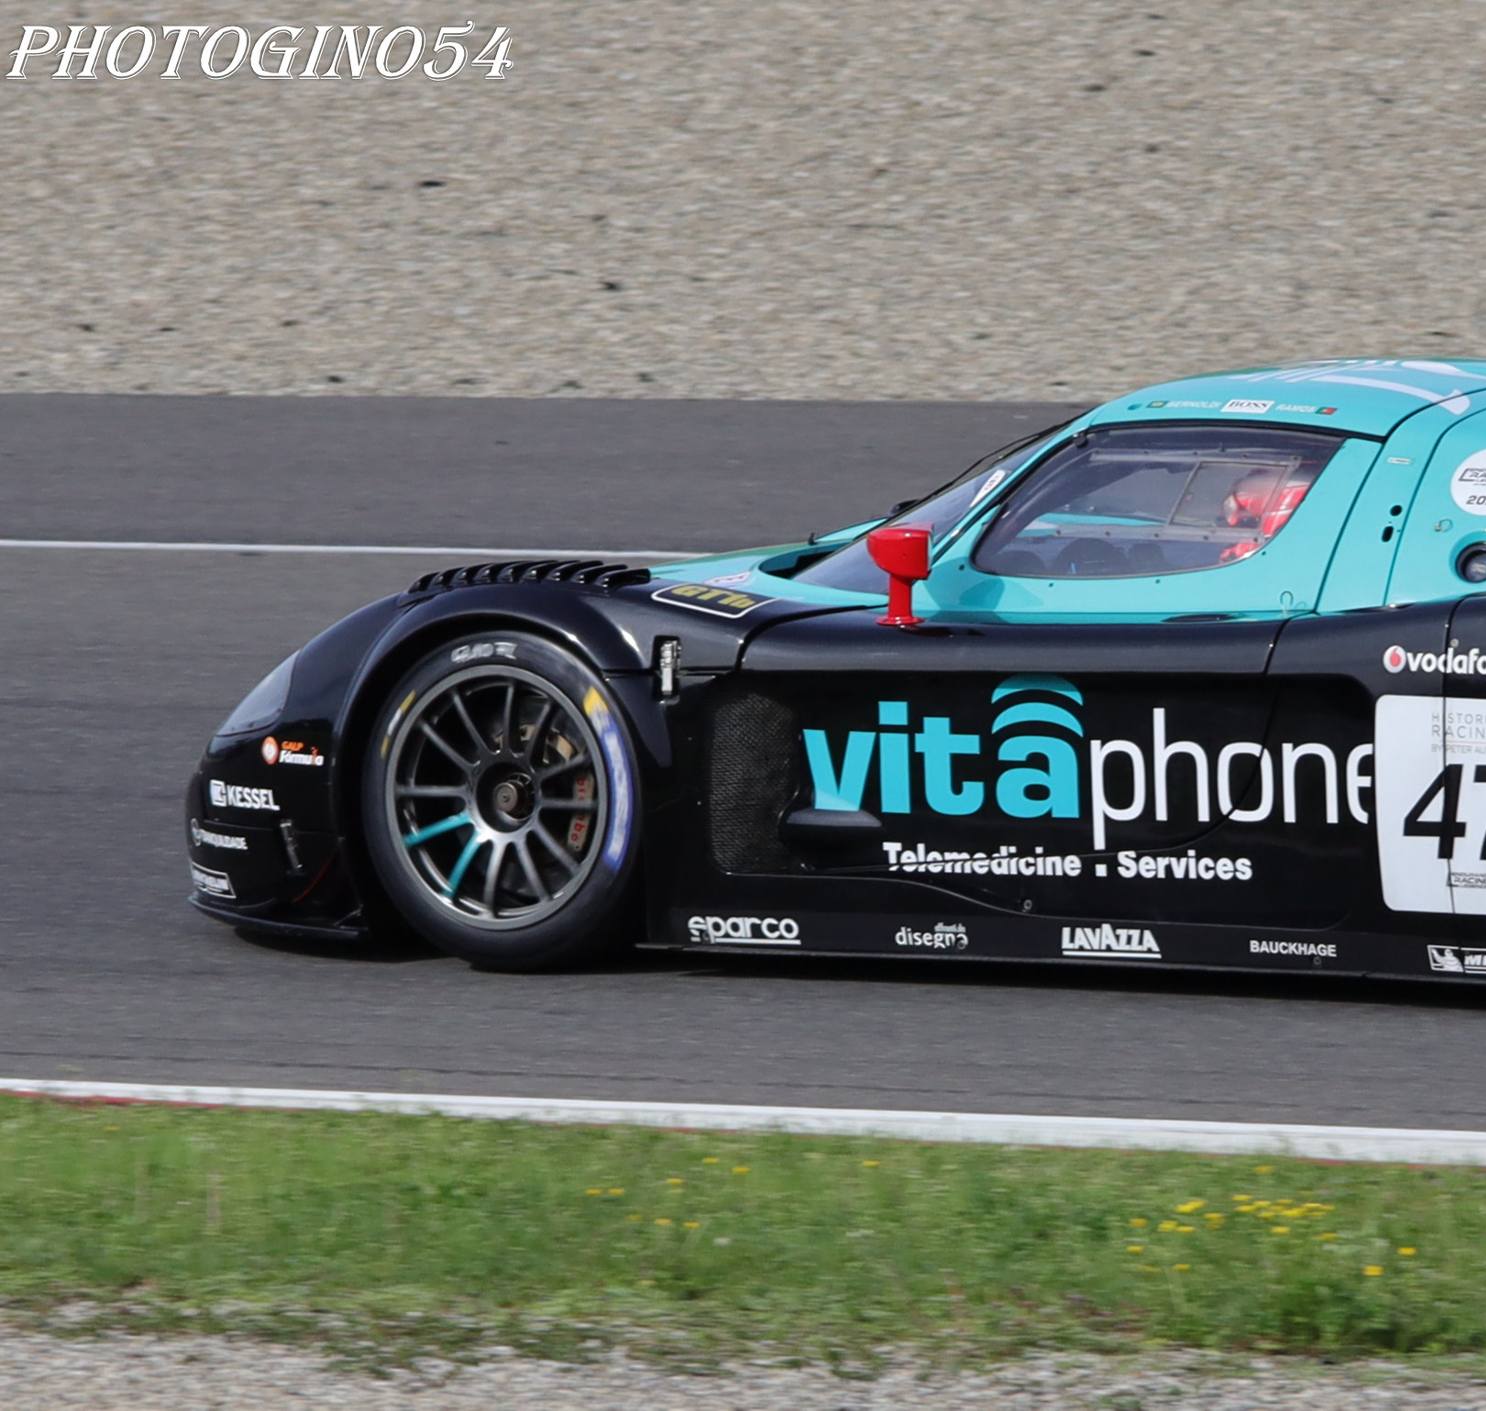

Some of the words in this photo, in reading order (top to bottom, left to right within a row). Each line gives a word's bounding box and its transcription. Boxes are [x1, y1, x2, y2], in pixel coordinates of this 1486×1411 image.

[226, 784, 281, 812] KESSEL
[882, 841, 1082, 877] Telemedicine
[1116, 849, 1253, 881] Services
[687, 915, 800, 945] sparco
[1061, 923, 1160, 952] LAVAZZA
[1249, 939, 1338, 959] BAUCKHAGE
